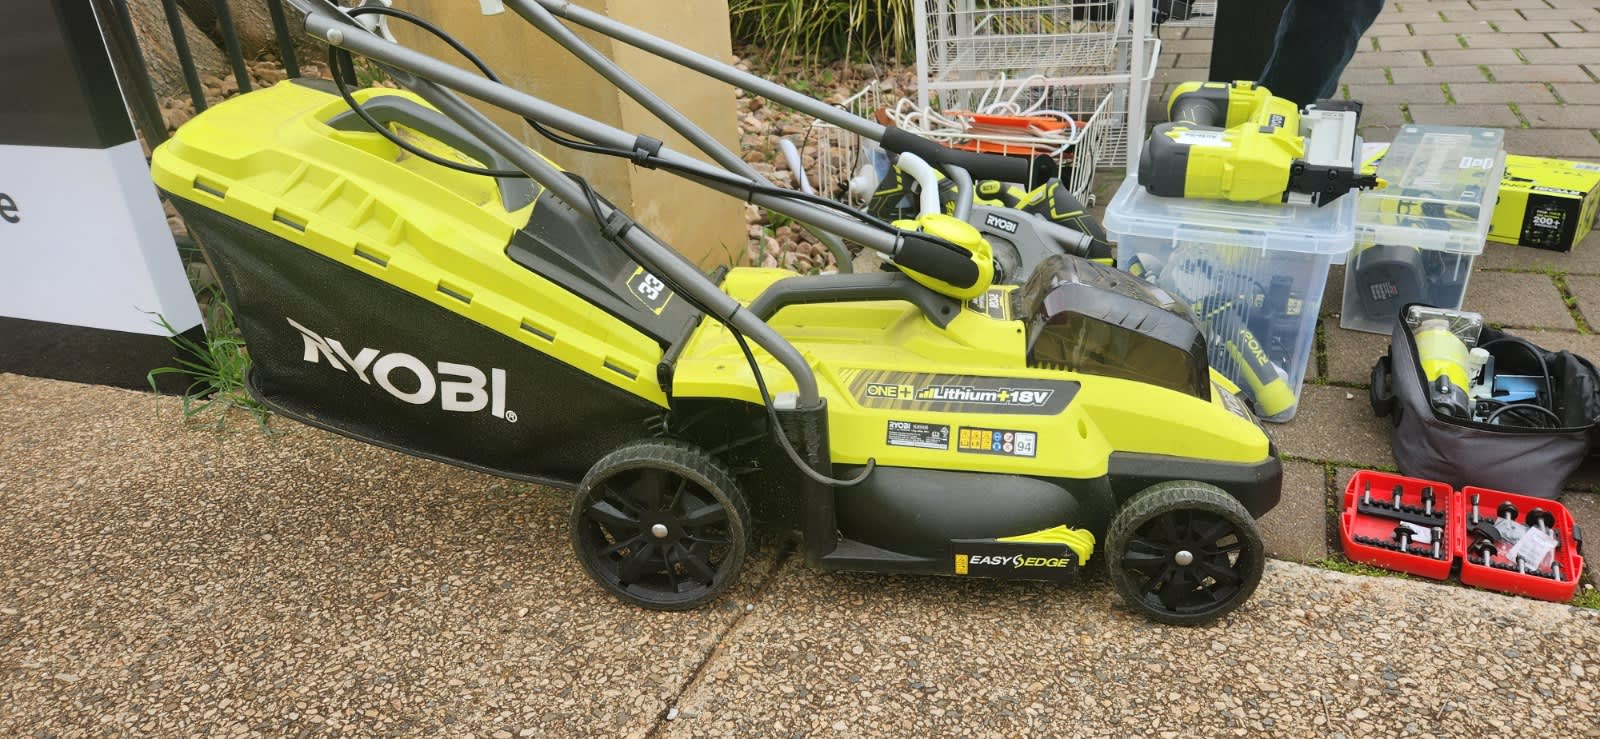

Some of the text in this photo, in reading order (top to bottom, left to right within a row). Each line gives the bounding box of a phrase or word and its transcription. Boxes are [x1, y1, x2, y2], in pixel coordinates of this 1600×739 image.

[986, 214, 1018, 233] RYOBI
[638, 273, 665, 300] 33
[1017, 441, 1032, 452] 94
[969, 555, 1070, 568] EASY EDGE
